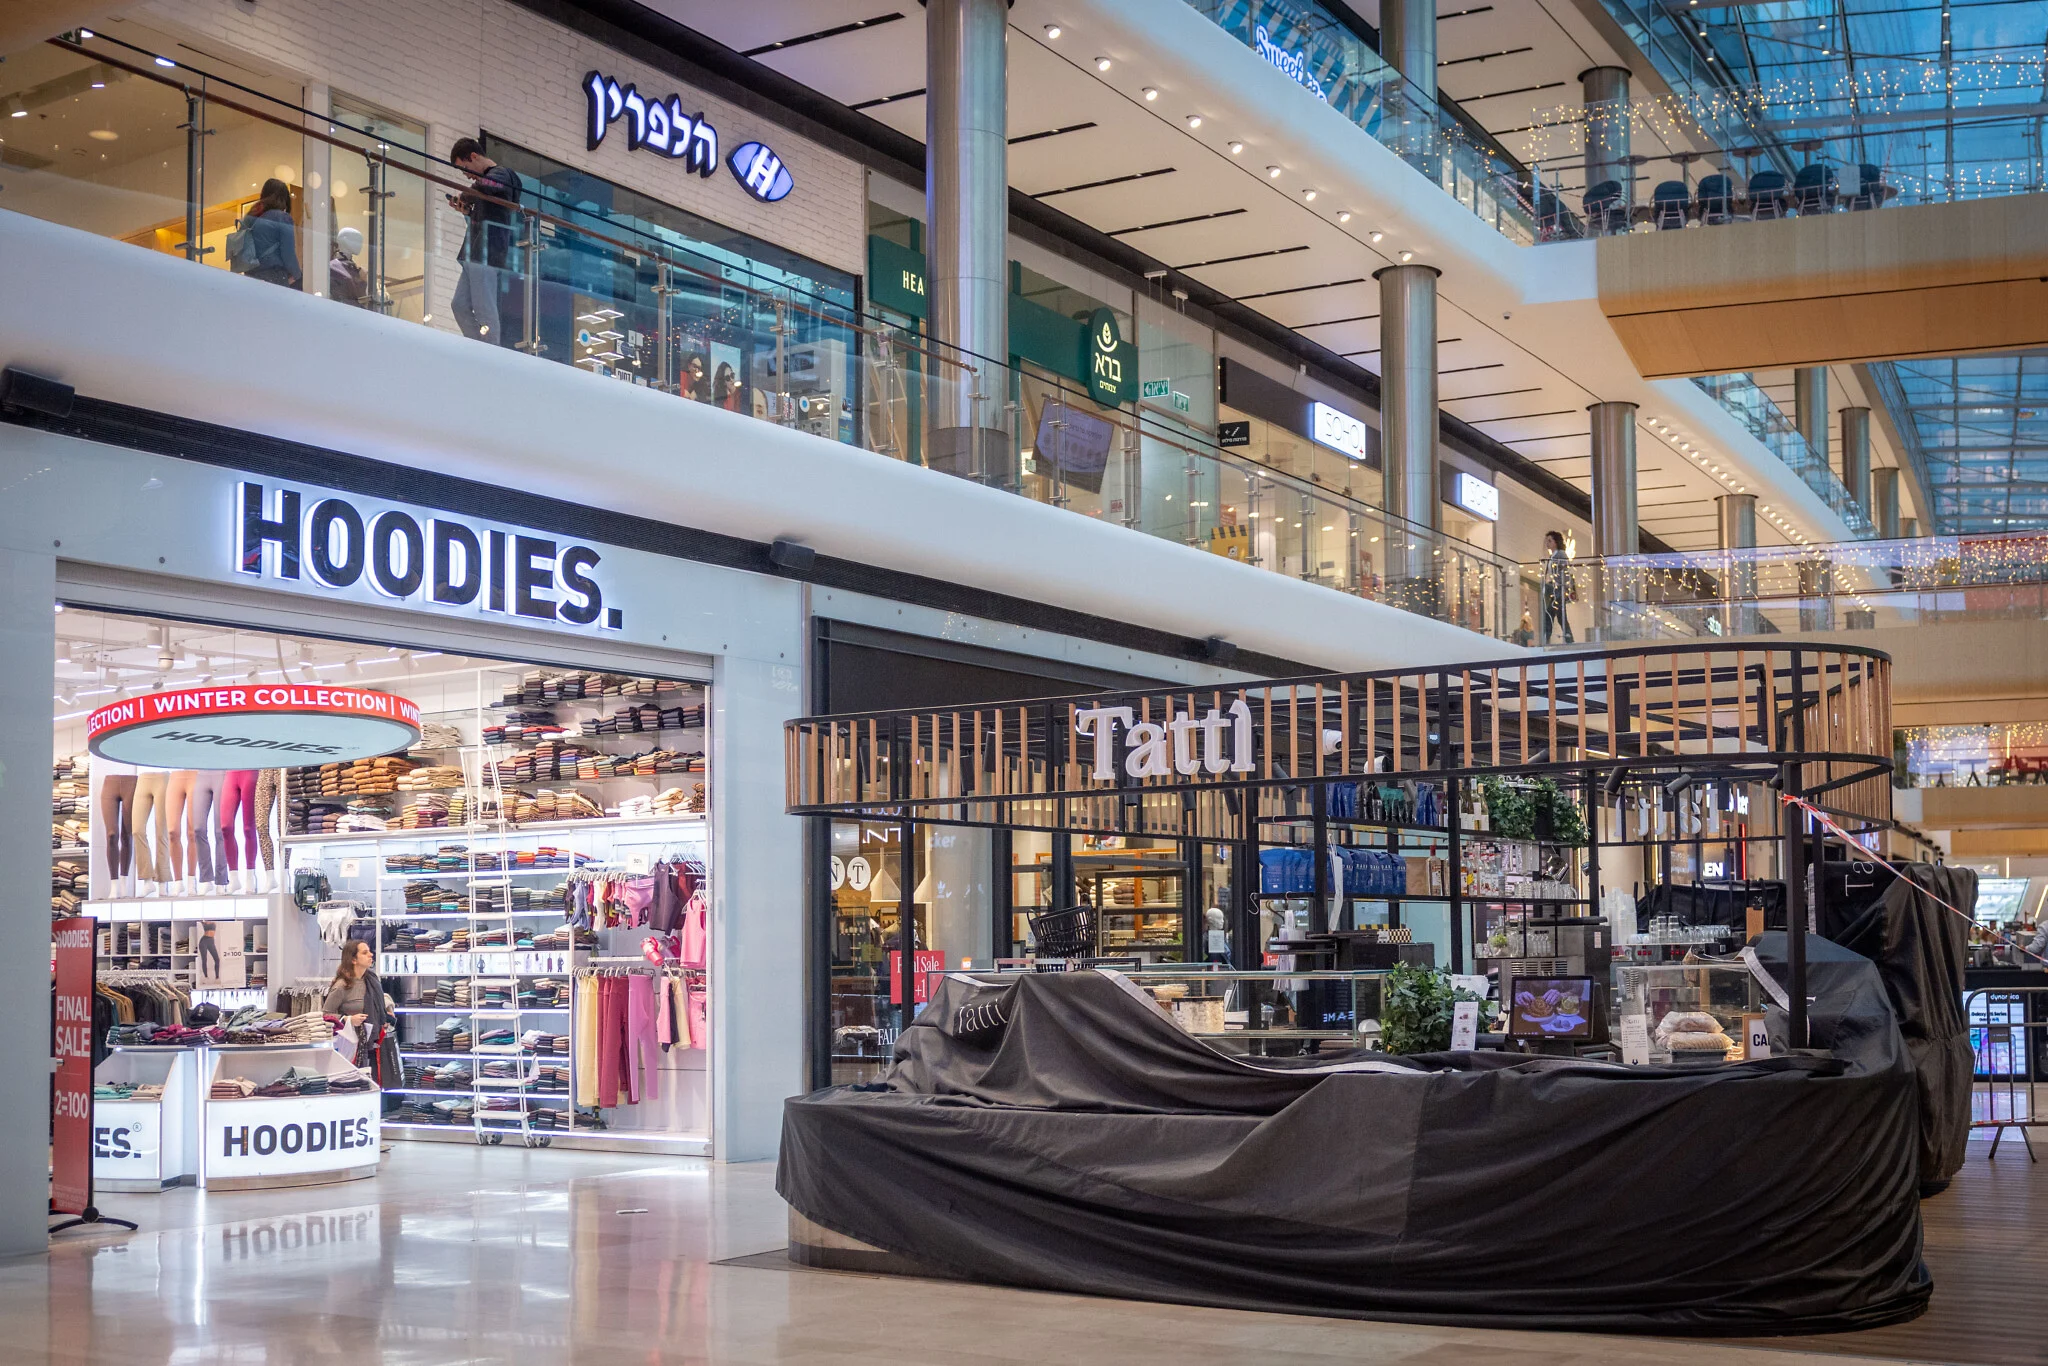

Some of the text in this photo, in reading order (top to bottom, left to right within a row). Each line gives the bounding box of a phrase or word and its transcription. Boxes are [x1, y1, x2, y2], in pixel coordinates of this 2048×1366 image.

[585, 71, 718, 176] הלפרין
[1095, 352, 1121, 382] ברא
[237, 481, 623, 630] HOODIES.
[154, 690, 245, 714] WINTER
[254, 689, 387, 712] COLLECTION
[152, 731, 342, 755] HOODIES.
[1703, 862, 1724, 877] EN
[55, 929, 92, 948] HOODIES.
[921, 956, 940, 973] Sale
[57, 995, 92, 1021] FINAL
[56, 1027, 91, 1057] SALE
[223, 1117, 374, 1157] HOODIES.
